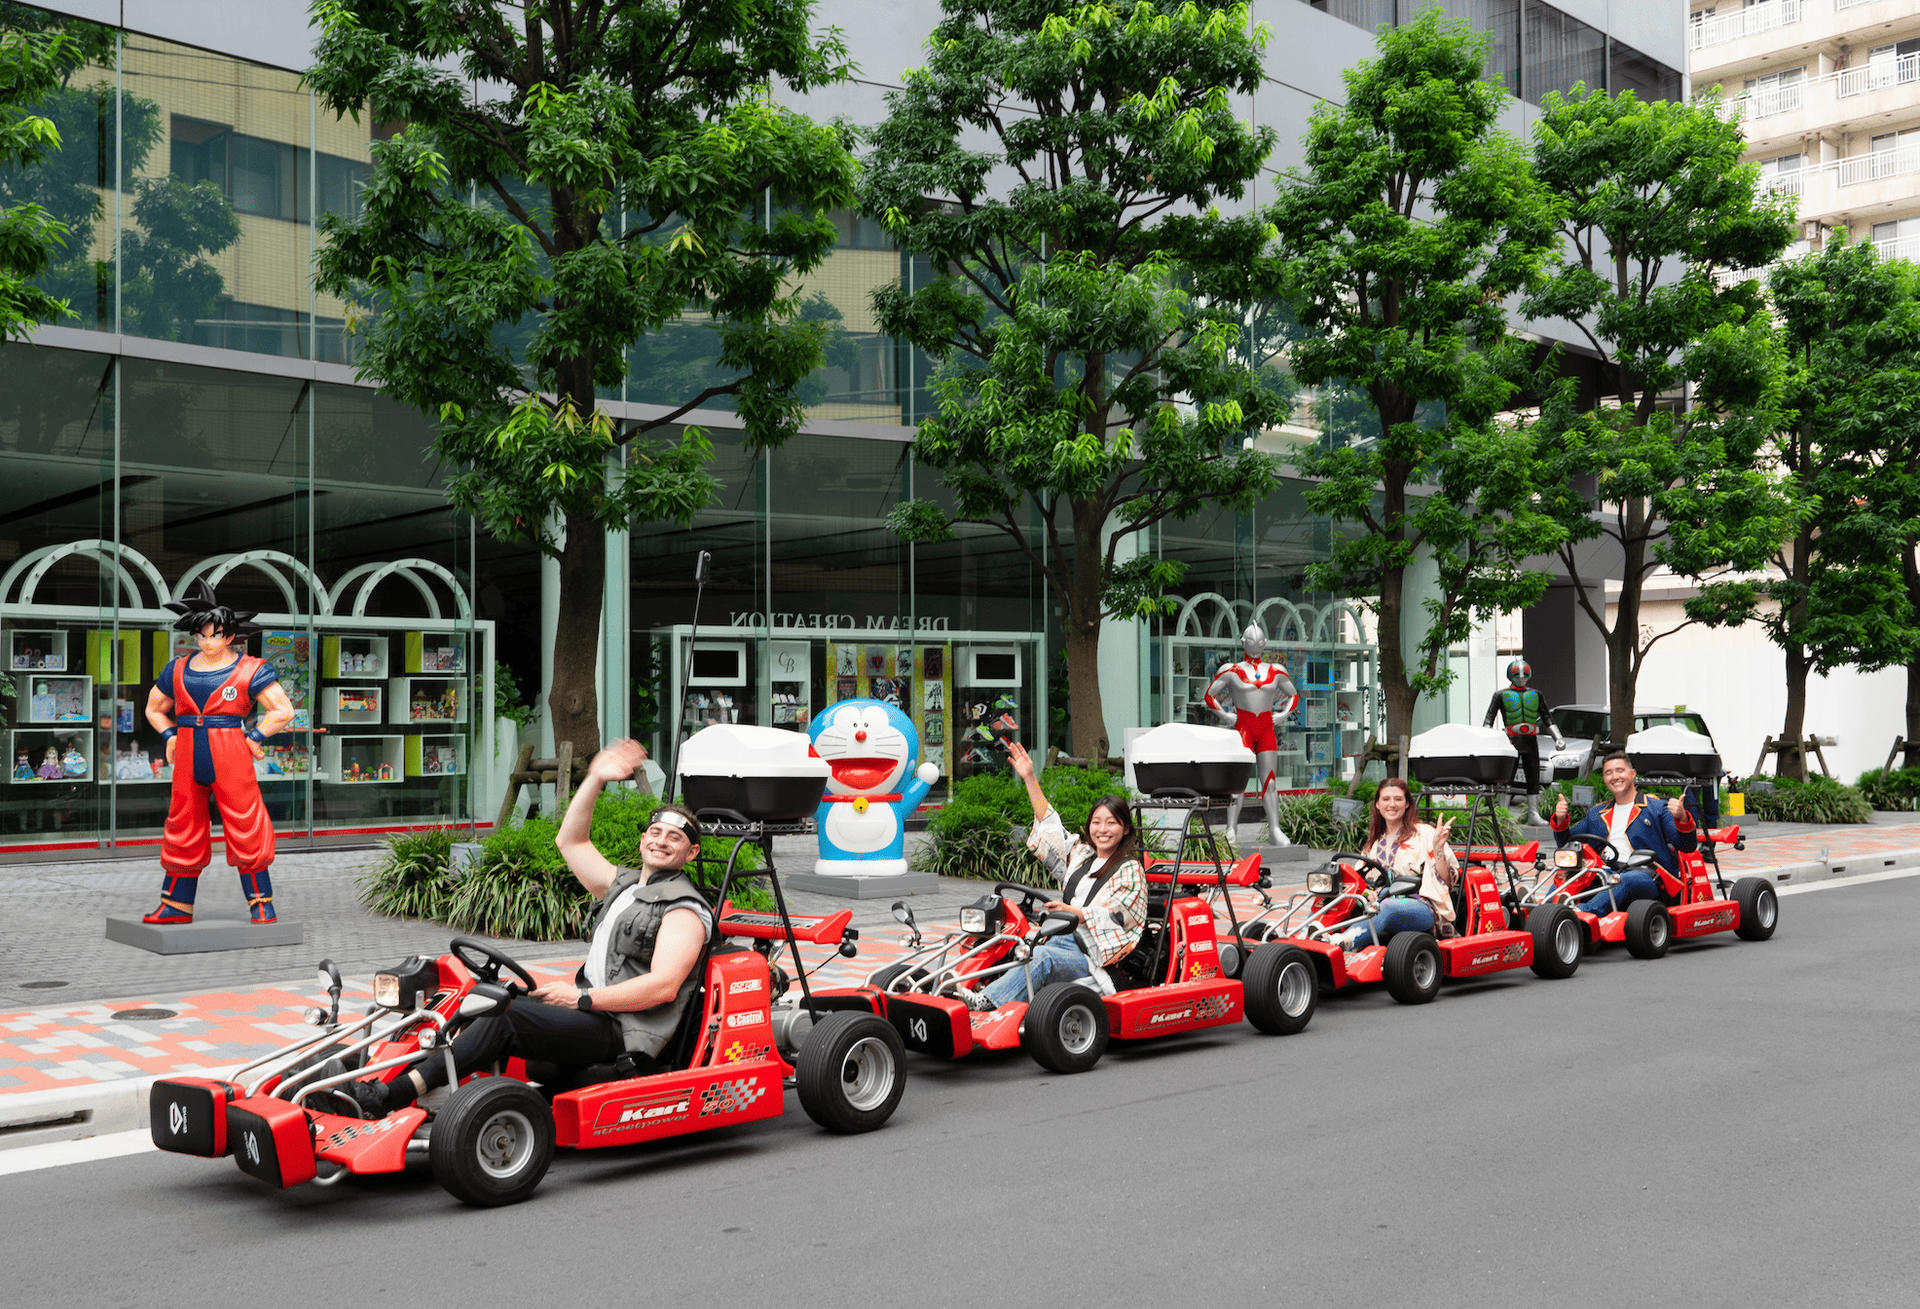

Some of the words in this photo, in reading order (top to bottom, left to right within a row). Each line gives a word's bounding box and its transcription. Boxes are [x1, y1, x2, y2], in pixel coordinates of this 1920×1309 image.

[1472, 953, 1500, 965] Kart
[1150, 1008, 1193, 1024] Kart
[619, 1100, 690, 1123] Kart
[702, 1098, 736, 1113] 50
[593, 1113, 690, 1136] streetpower
